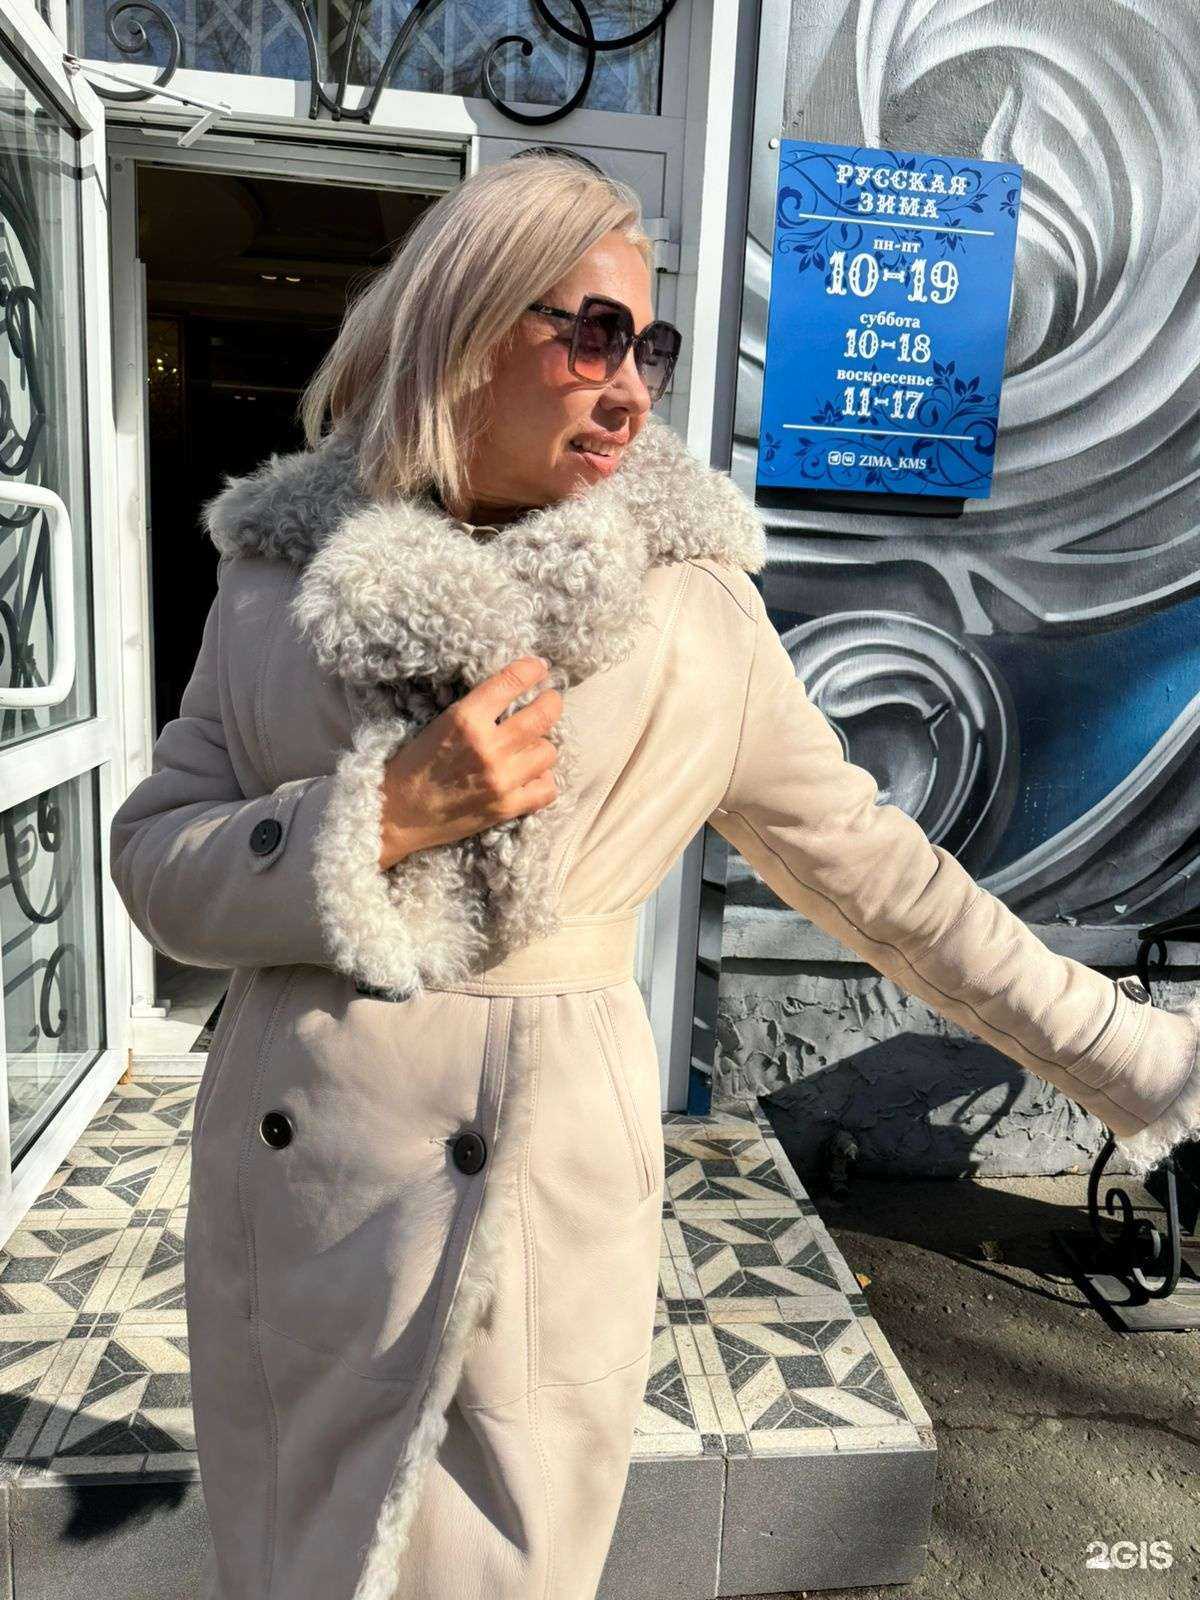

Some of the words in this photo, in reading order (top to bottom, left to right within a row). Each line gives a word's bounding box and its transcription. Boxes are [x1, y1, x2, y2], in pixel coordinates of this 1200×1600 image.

[836, 164, 967, 196] РУССКАЯ
[857, 191, 939, 220] ЗИМА
[873, 238, 921, 253] пн-пт
[826, 250, 959, 304] 10-19
[859, 311, 921, 330] суббота
[843, 328, 931, 363] 10-18
[836, 369, 934, 388] воскресенье
[842, 387, 924, 420] 11-17
[858, 454, 927, 470] ZIMA_KMS
